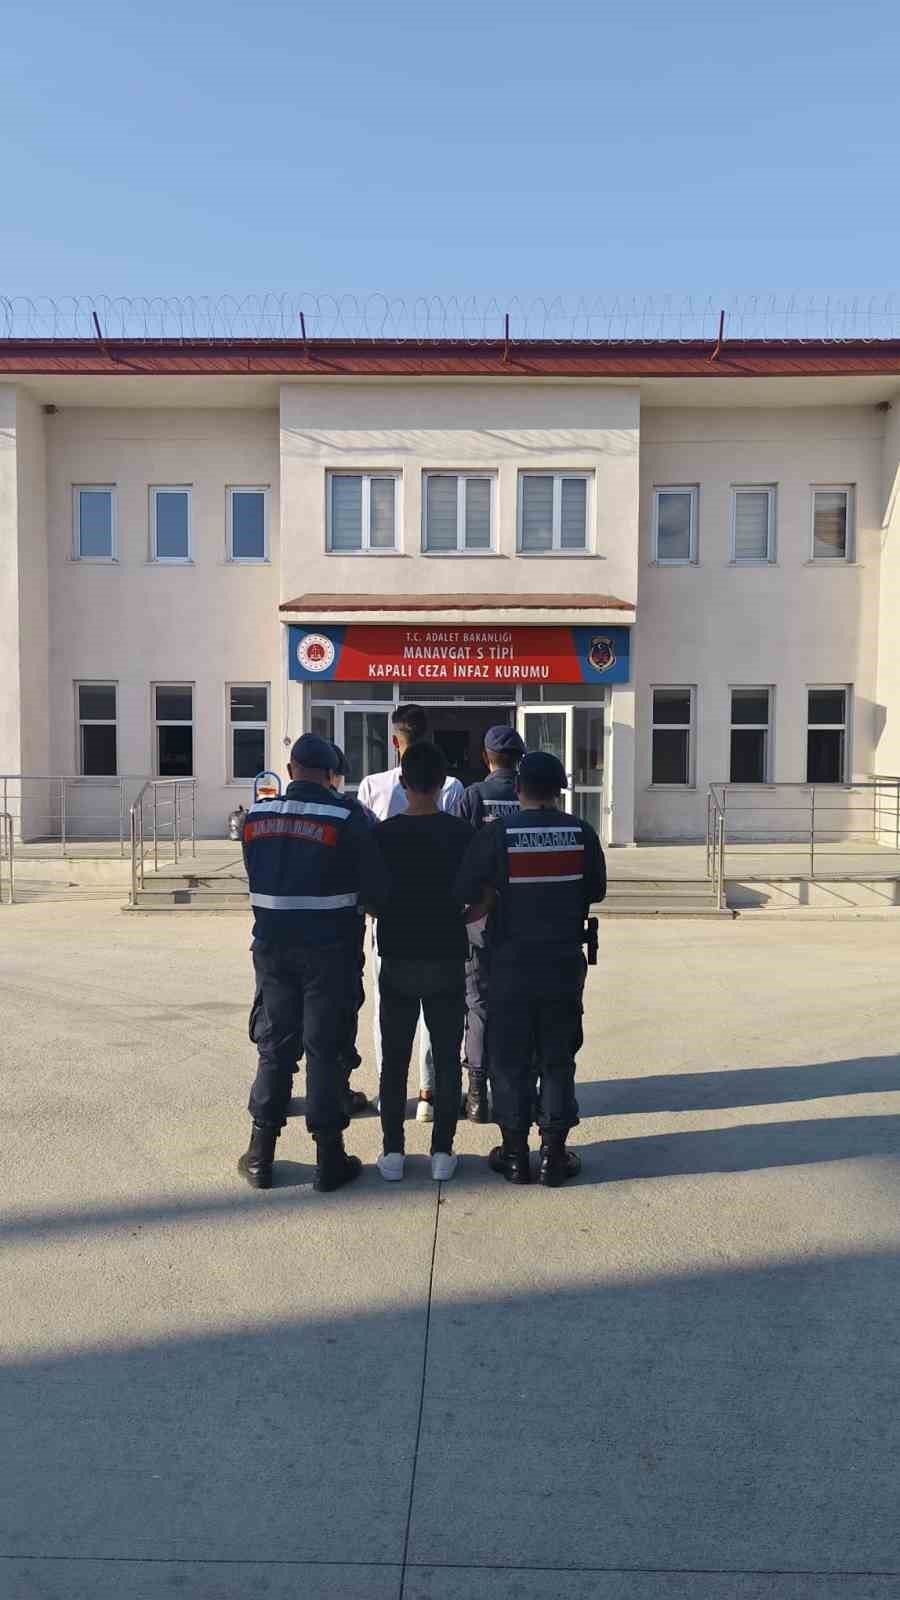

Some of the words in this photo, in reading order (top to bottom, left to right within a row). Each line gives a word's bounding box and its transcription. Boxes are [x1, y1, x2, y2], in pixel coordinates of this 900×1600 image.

[406, 632, 421, 642] T.C.
[426, 632, 459, 642] ADALET
[463, 631, 512, 642] BAKANLIĞI
[403, 646, 470, 659] MANAVGAT
[477, 646, 484, 660] S
[489, 644, 514, 660] TİPİ
[368, 664, 412, 677] KAPALI
[418, 664, 447, 677] CEZA
[453, 662, 489, 677] İNFAZ
[495, 665, 549, 678] KURUMU
[515, 831, 576, 848] JANDARMA
